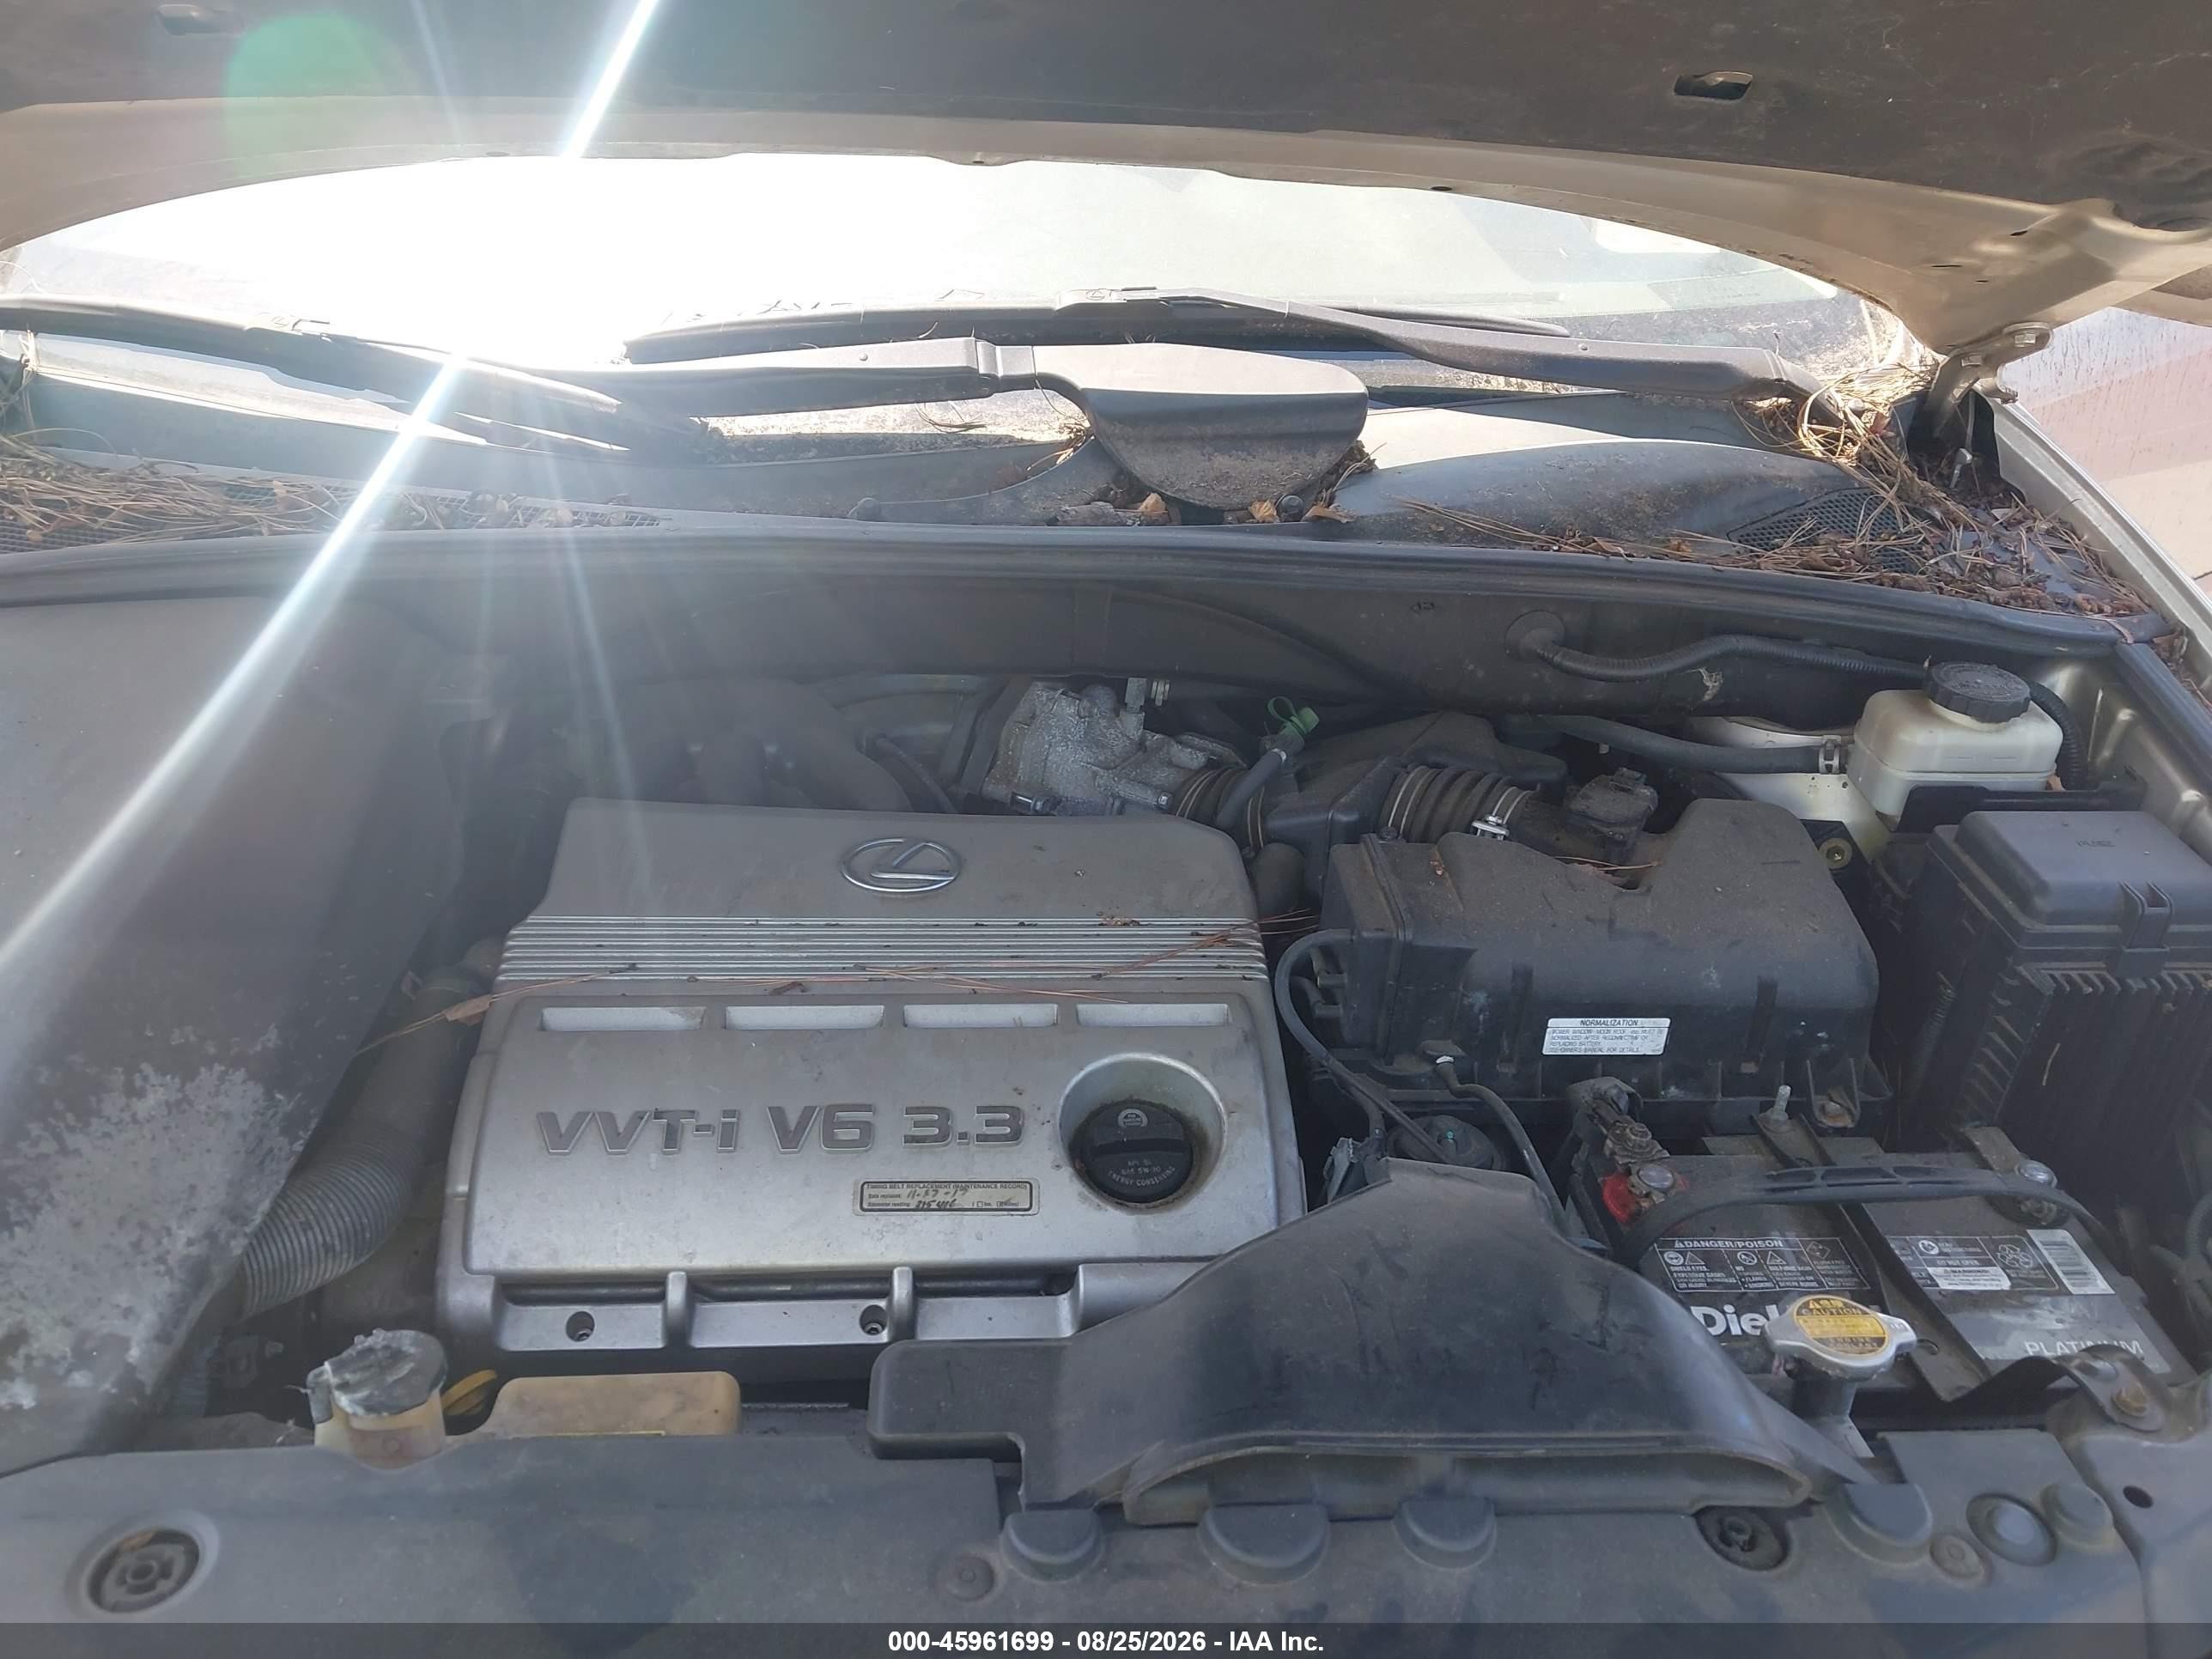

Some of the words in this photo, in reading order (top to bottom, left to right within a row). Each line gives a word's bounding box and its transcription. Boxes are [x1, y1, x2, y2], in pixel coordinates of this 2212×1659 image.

[536, 1109, 741, 1155] VVT-i
[767, 1103, 874, 1155] V6
[902, 1105, 1024, 1149] 3.3
[1684, 1240, 1784, 1249] DANGER/POISON
[1801, 1307, 1863, 1316] CAUTION
